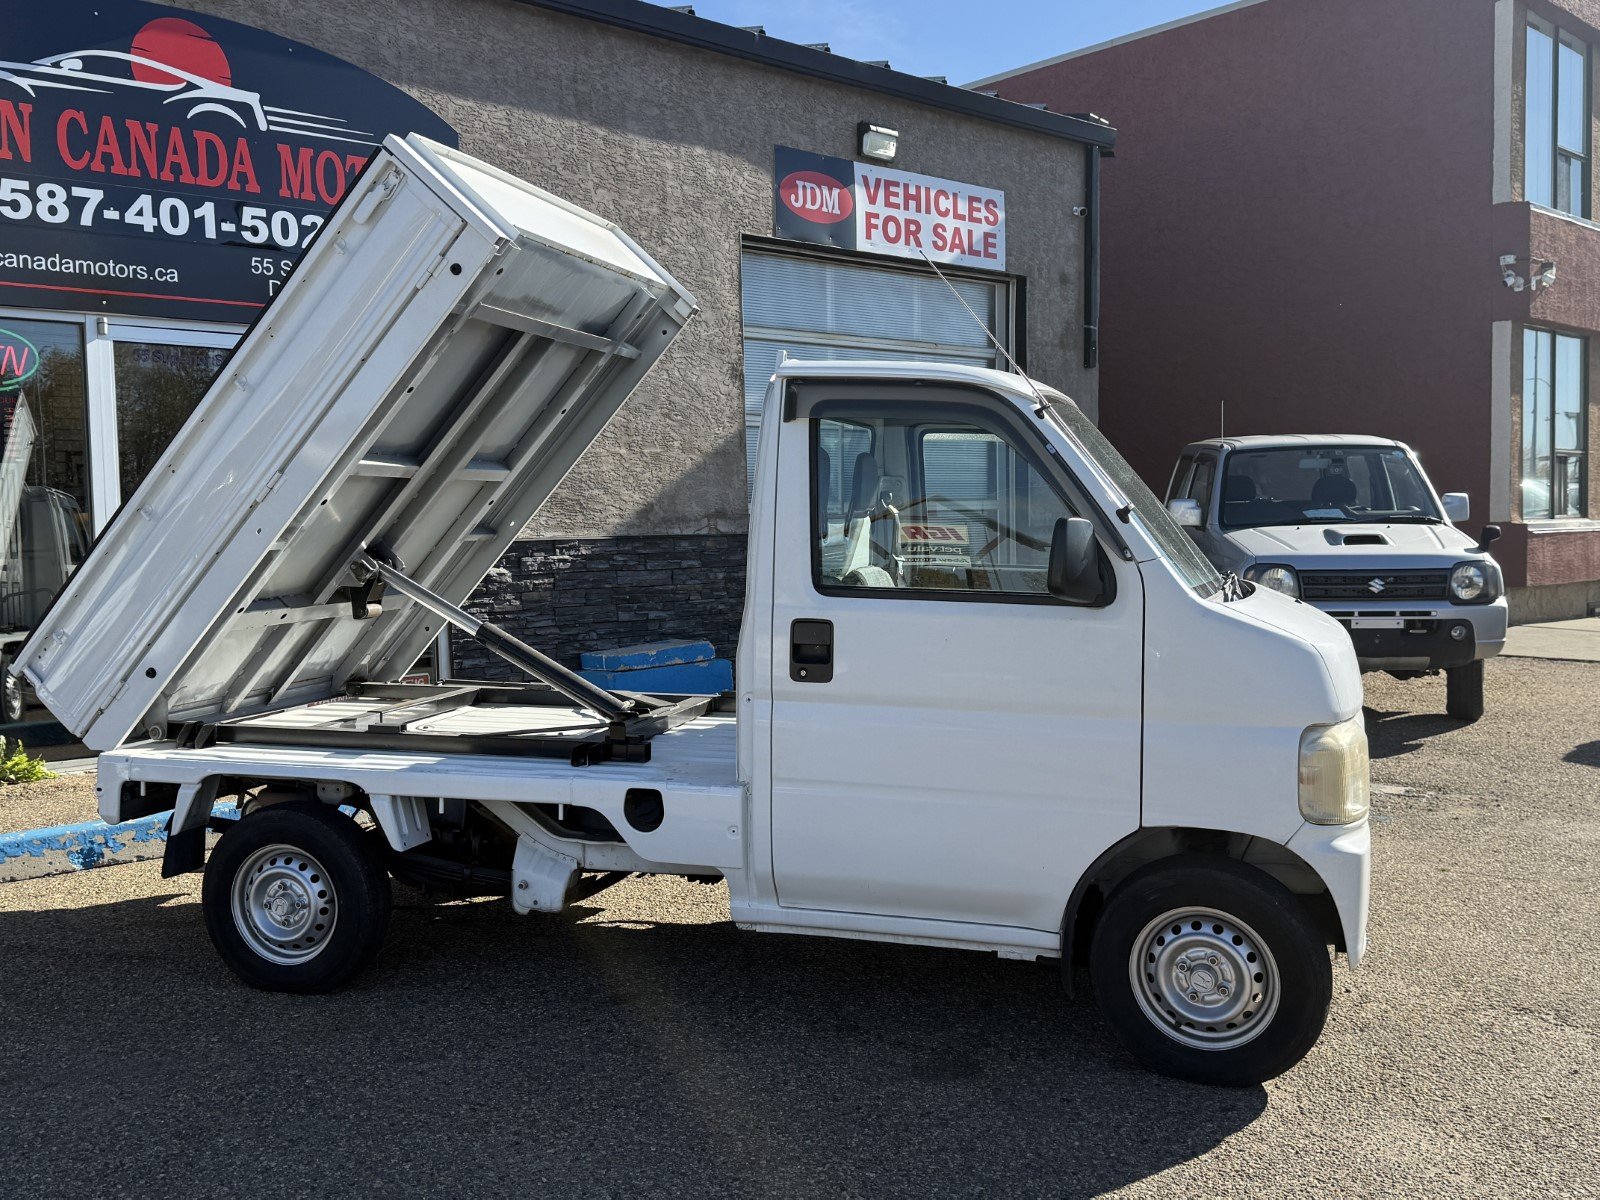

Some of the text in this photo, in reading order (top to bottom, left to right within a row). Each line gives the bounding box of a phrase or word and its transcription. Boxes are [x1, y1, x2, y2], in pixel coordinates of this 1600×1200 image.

[57, 108, 261, 193] CANADA
[790, 180, 841, 215] JDM
[861, 174, 999, 227] VEHICLES
[865, 211, 998, 260] FOR SALE
[251, 257, 274, 276] 55
